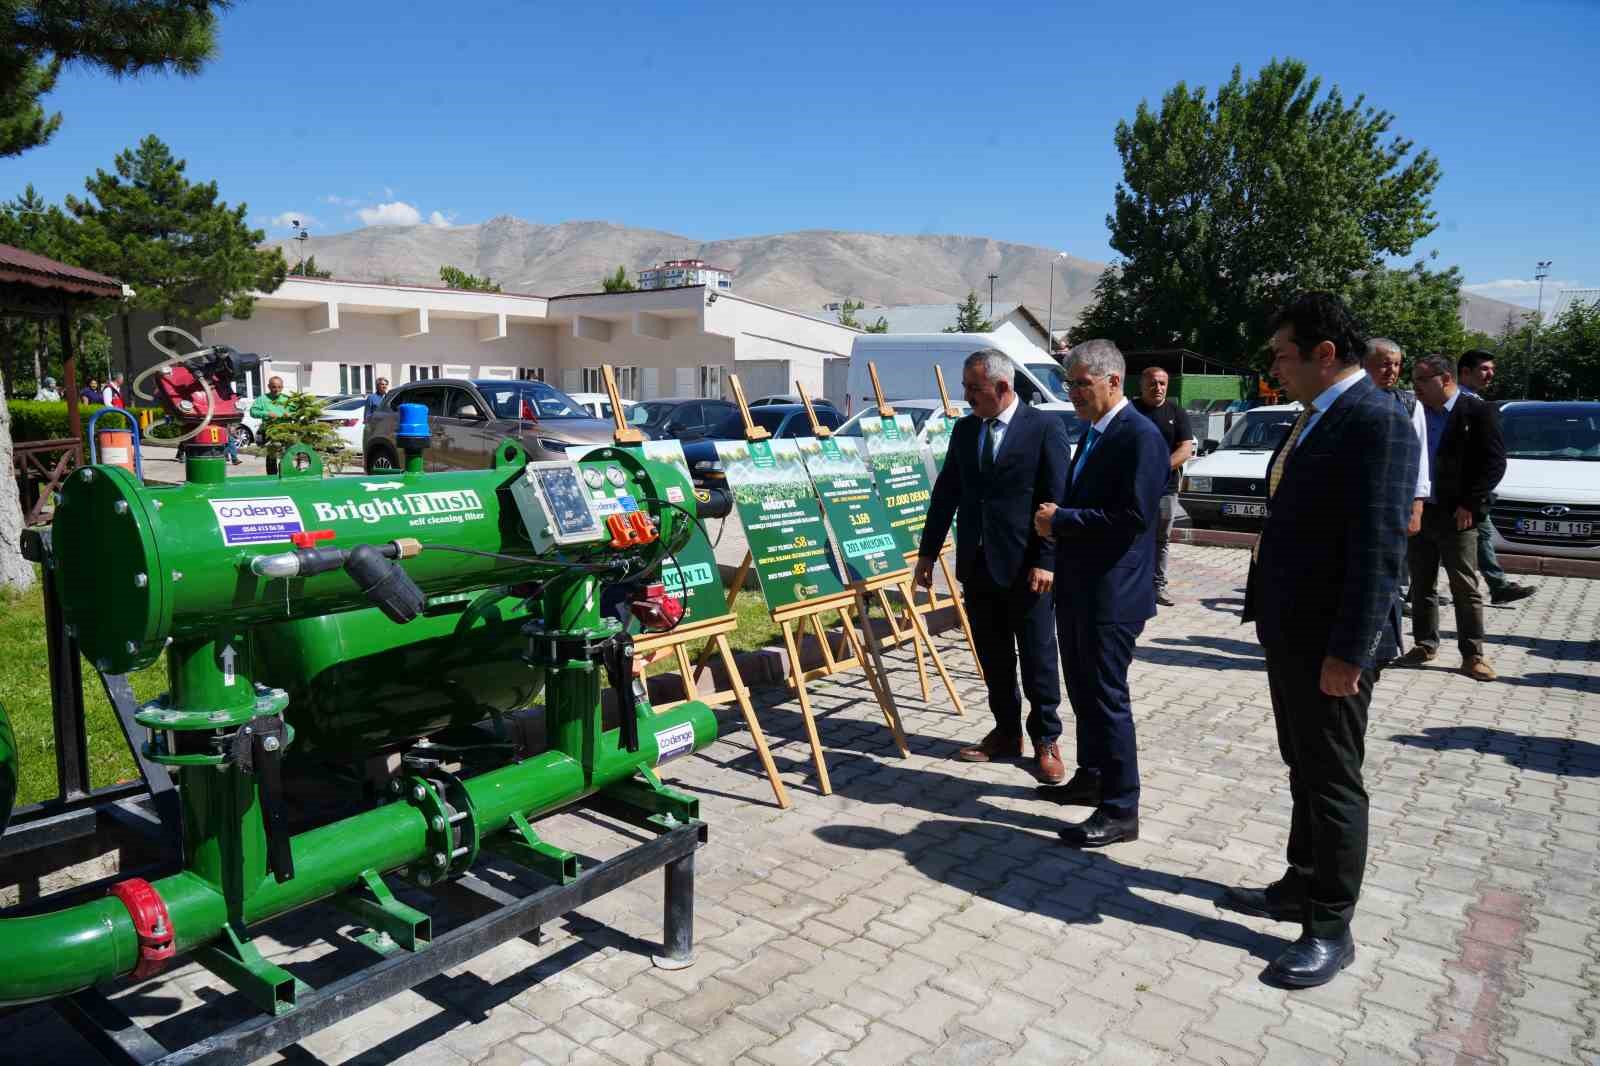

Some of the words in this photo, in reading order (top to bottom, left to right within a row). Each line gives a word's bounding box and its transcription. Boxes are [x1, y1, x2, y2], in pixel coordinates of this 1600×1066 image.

[427, 513, 464, 525] cleaning
[1522, 519, 1537, 531] 51
[1568, 522, 1590, 535] 115
[694, 567, 711, 581] TL
